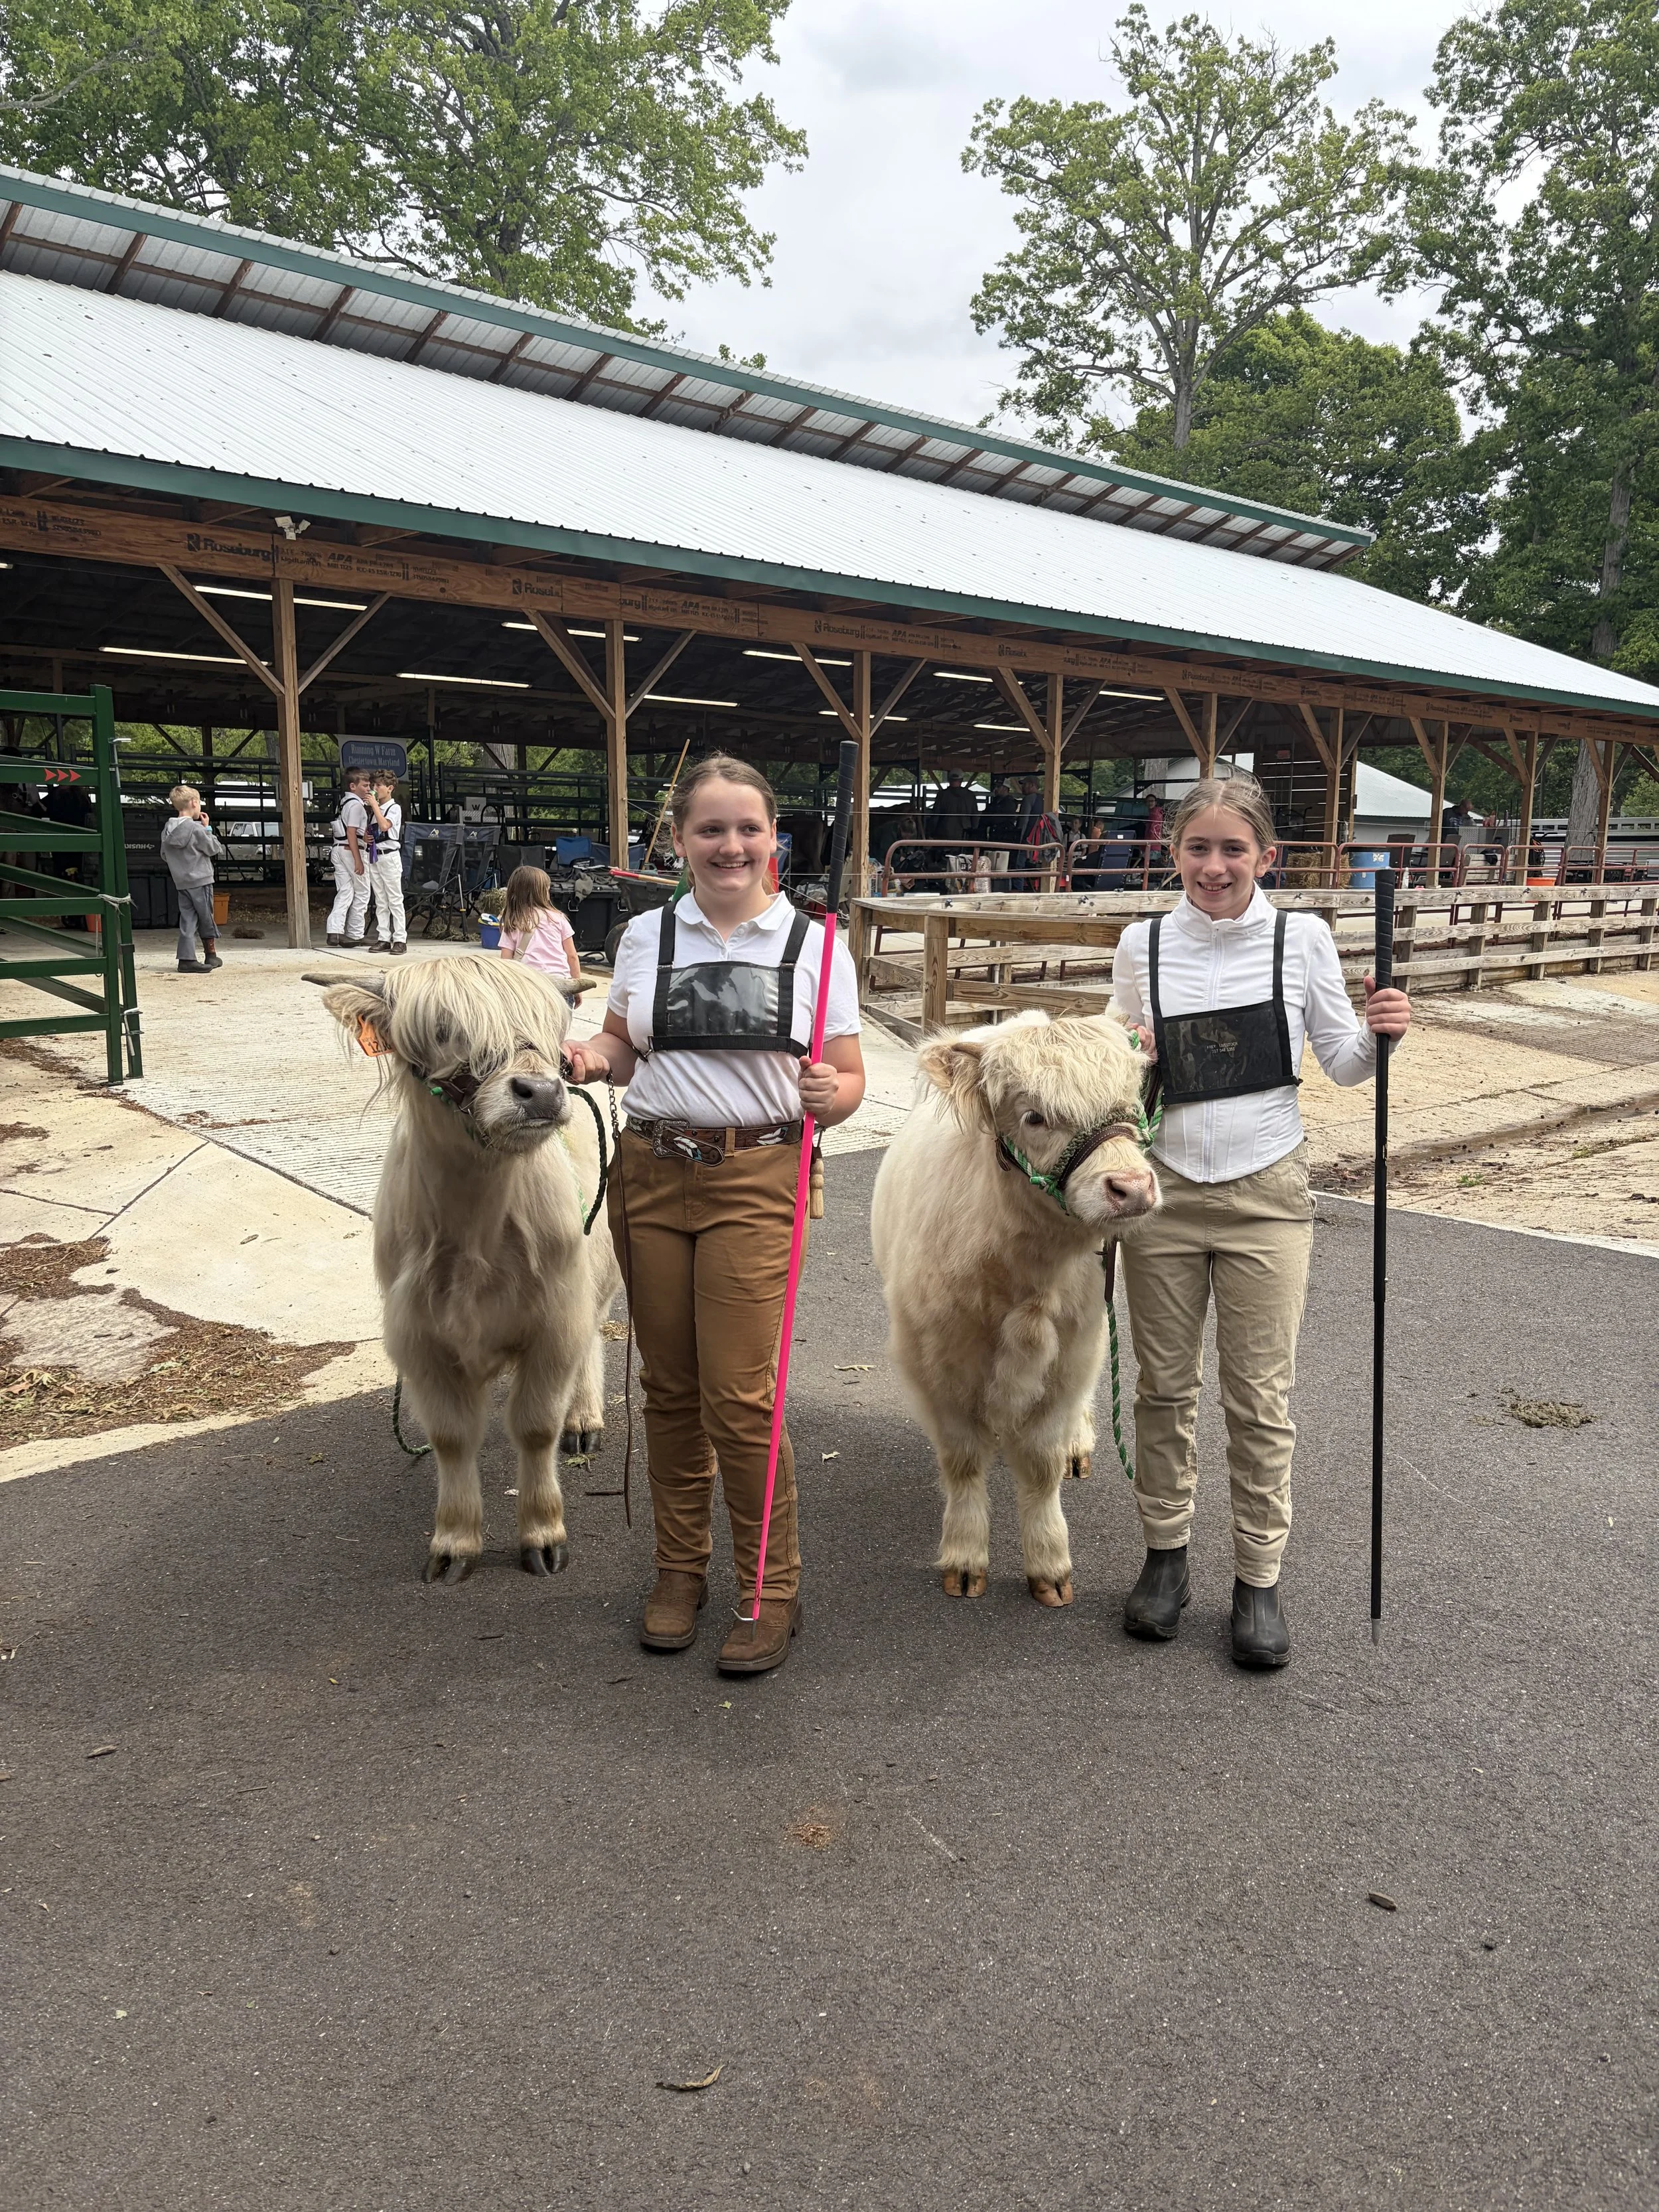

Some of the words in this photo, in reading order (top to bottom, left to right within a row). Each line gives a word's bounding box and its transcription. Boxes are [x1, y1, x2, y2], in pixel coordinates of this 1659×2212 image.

[203, 538, 272, 561] Roseburg
[328, 552, 352, 562] APA
[823, 623, 861, 638] Roseburg
[351, 744, 374, 756] Running
[375, 745, 381, 755] W
[382, 746, 396, 756] Farm
[378, 758, 399, 767] Maryland
